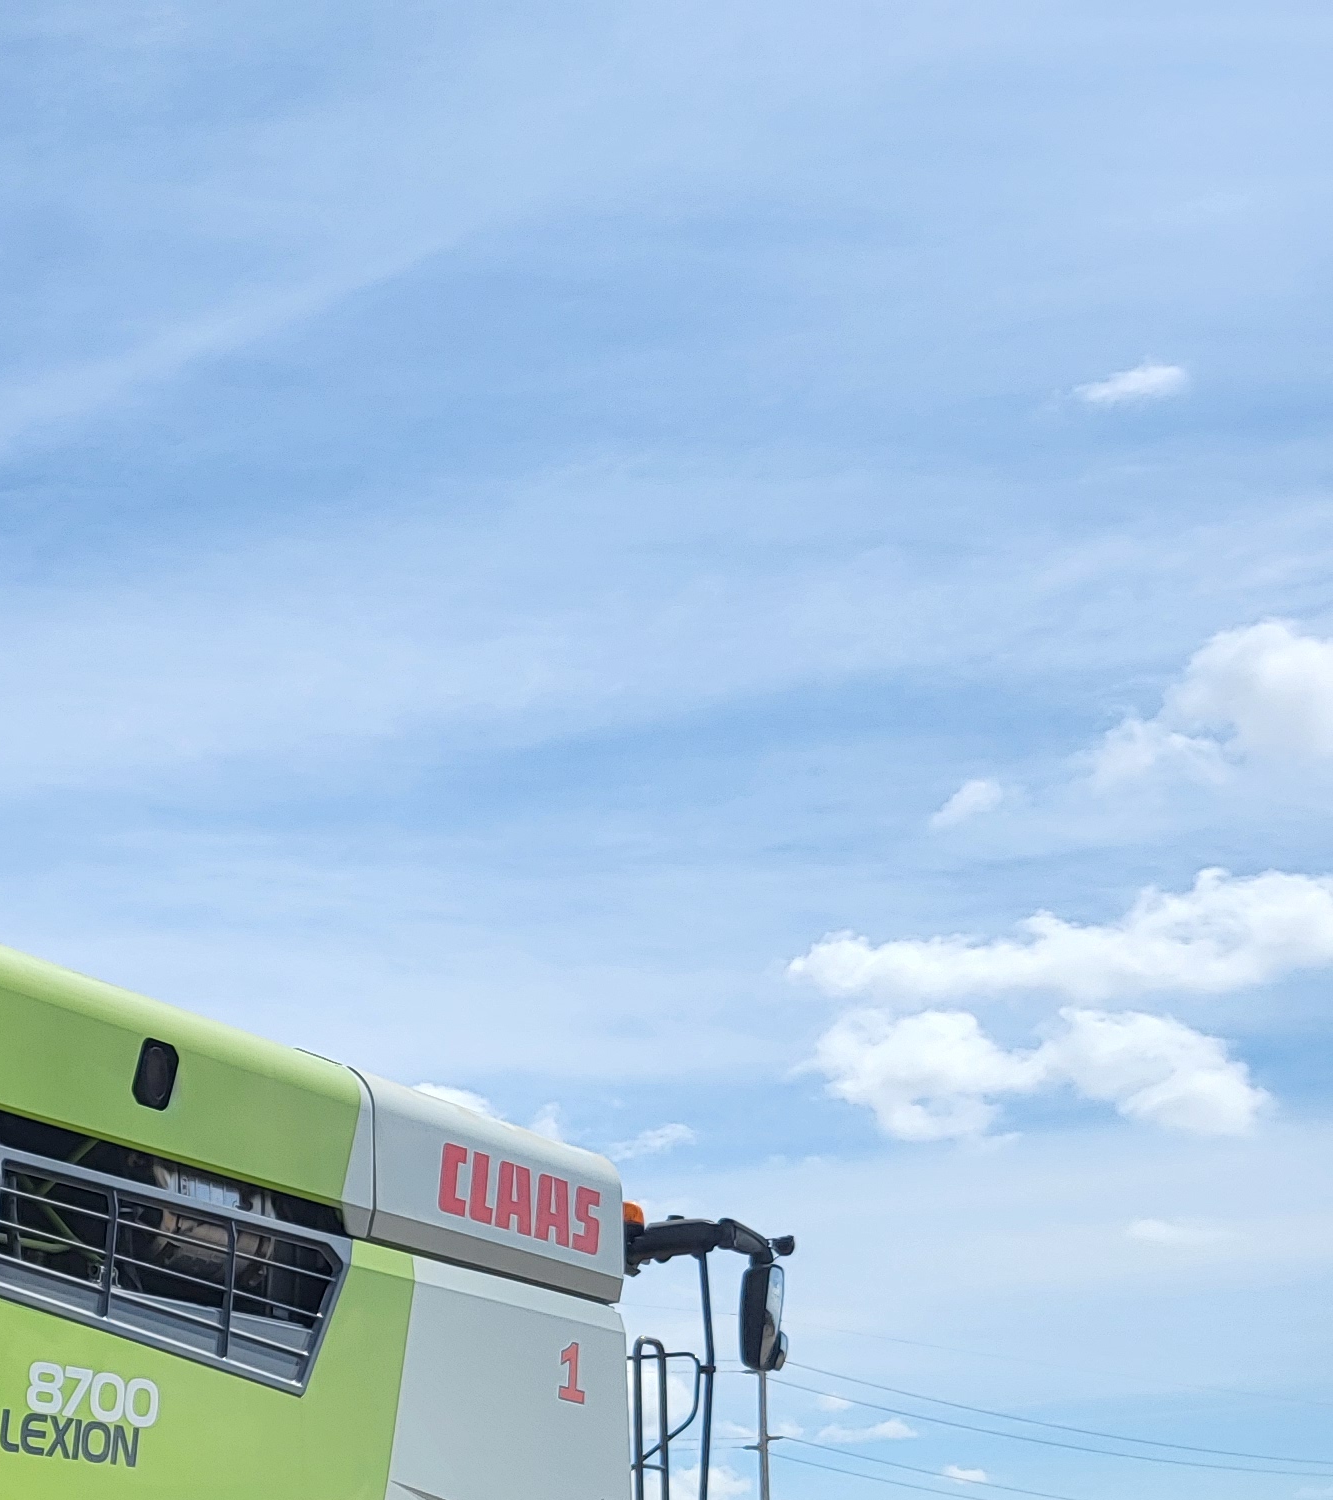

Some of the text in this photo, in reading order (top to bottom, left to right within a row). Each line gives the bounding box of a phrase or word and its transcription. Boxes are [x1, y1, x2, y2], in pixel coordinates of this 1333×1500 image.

[438, 1142, 601, 1256] CLAAS
[26, 1360, 160, 1428] 8700
[557, 1341, 586, 1406] 1
[0, 1408, 140, 1468] LEXION
